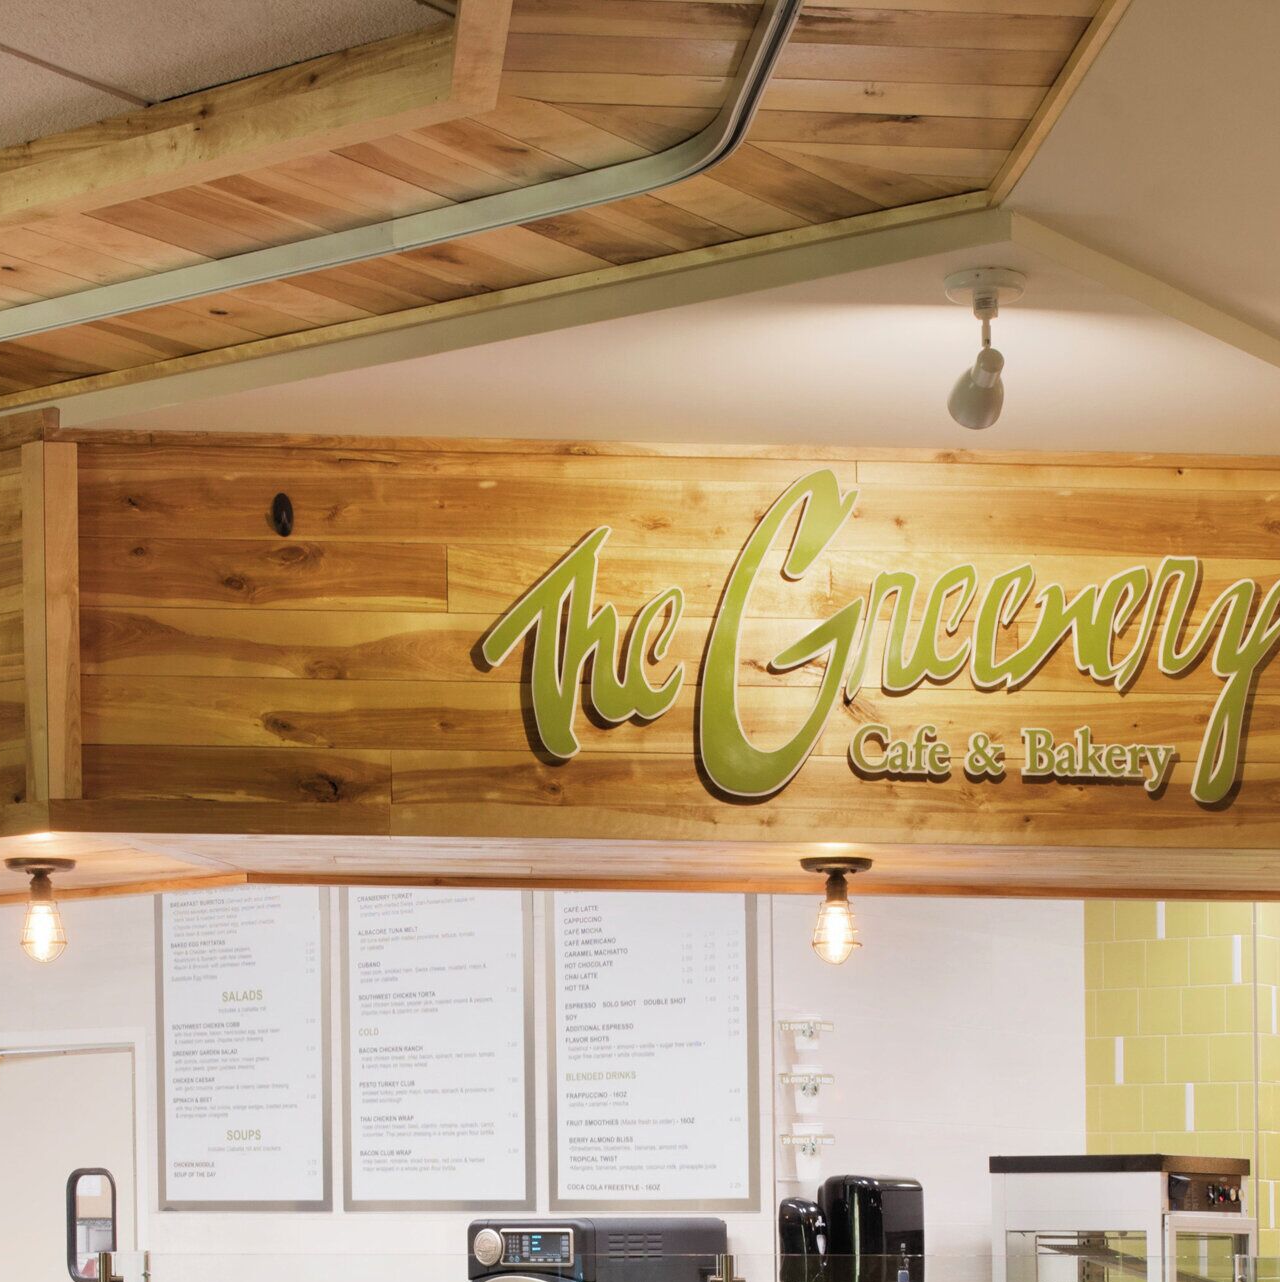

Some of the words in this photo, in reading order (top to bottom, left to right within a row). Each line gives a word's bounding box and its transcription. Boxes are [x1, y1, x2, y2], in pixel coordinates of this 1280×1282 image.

[484, 526, 685, 758] The
[850, 723, 951, 776] Cafe
[966, 732, 1007, 775] &
[1022, 728, 1176, 792] Bakery
[581, 905, 598, 913] LATTE
[564, 916, 602, 925] CAPPUCCINO
[565, 950, 592, 958] CARAMEL
[594, 948, 628, 956] MACHIATTO
[578, 960, 613, 969] CHOCOLATE
[222, 990, 263, 1002] SALADS
[565, 1002, 596, 1010] ESPRESSO
[644, 999, 668, 1007] DOUBLE
[602, 1023, 634, 1031] ESPRESSO
[359, 1028, 379, 1036] COLD
[566, 1036, 588, 1044] FLAVOR
[566, 1072, 603, 1081] BLENDED
[606, 1071, 636, 1080] DRINKS
[226, 1129, 261, 1141] SOUPS
[645, 1183, 661, 1191] 16OZ
